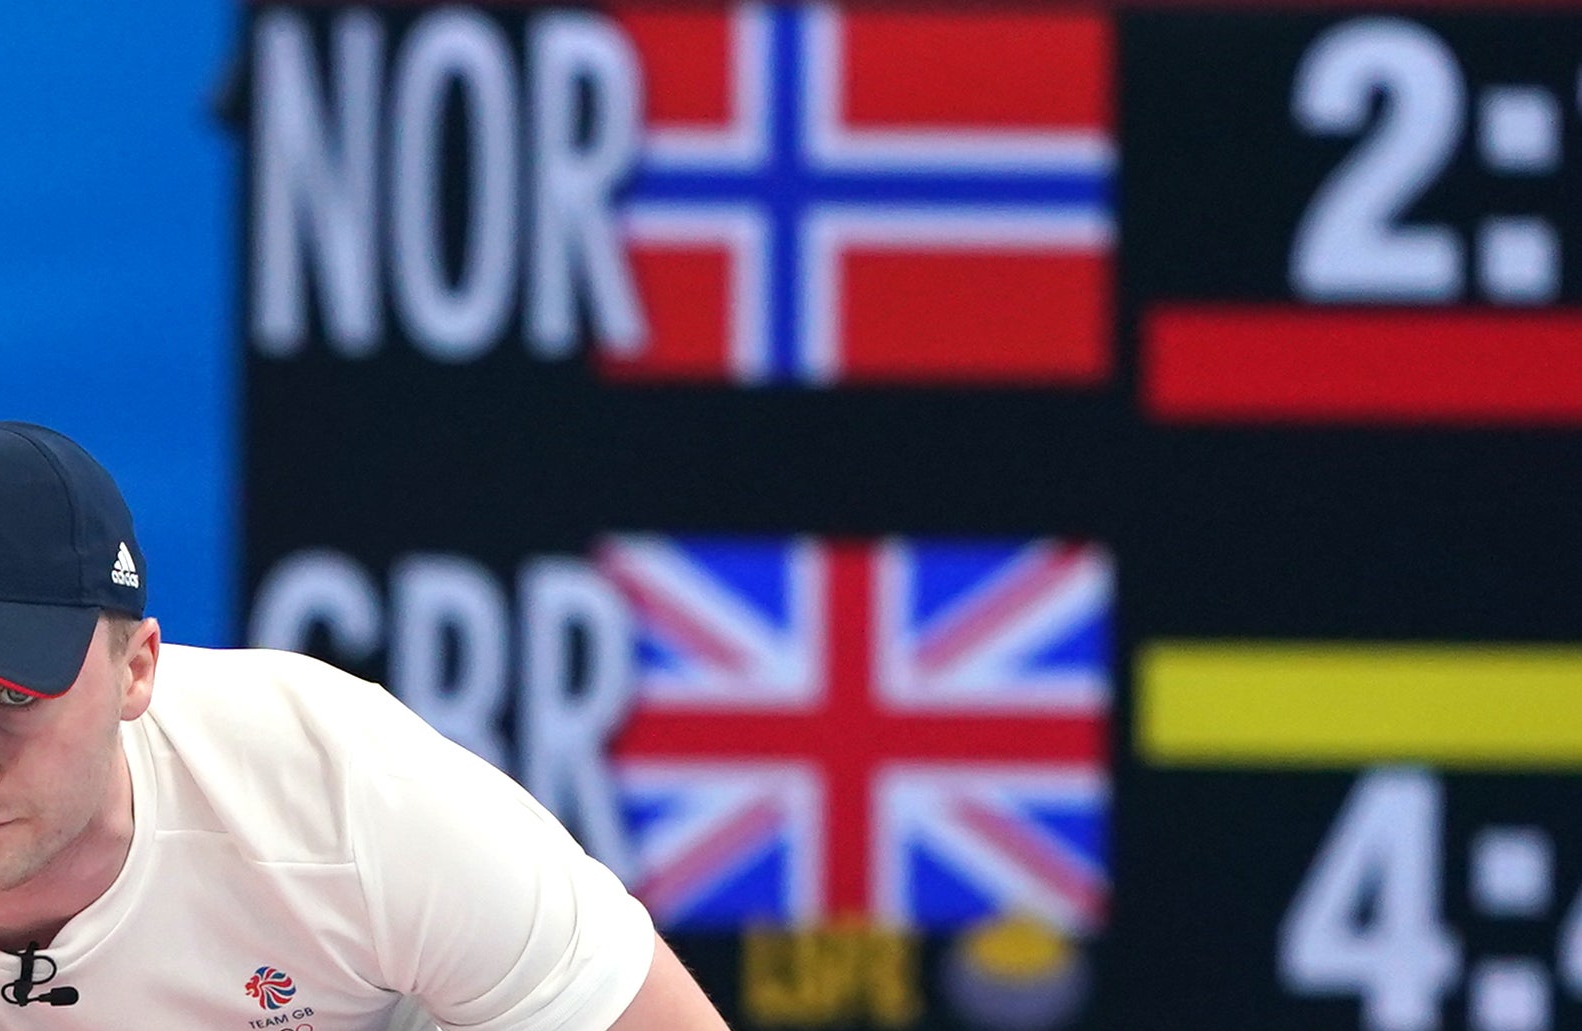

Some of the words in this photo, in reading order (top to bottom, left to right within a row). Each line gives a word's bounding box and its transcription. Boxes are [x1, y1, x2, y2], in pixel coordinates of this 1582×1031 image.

[254, 8, 649, 361] NOR
[1290, 16, 1582, 303] 2:
[248, 1013, 289, 1029] TEAM
[292, 1007, 314, 1020] GB
